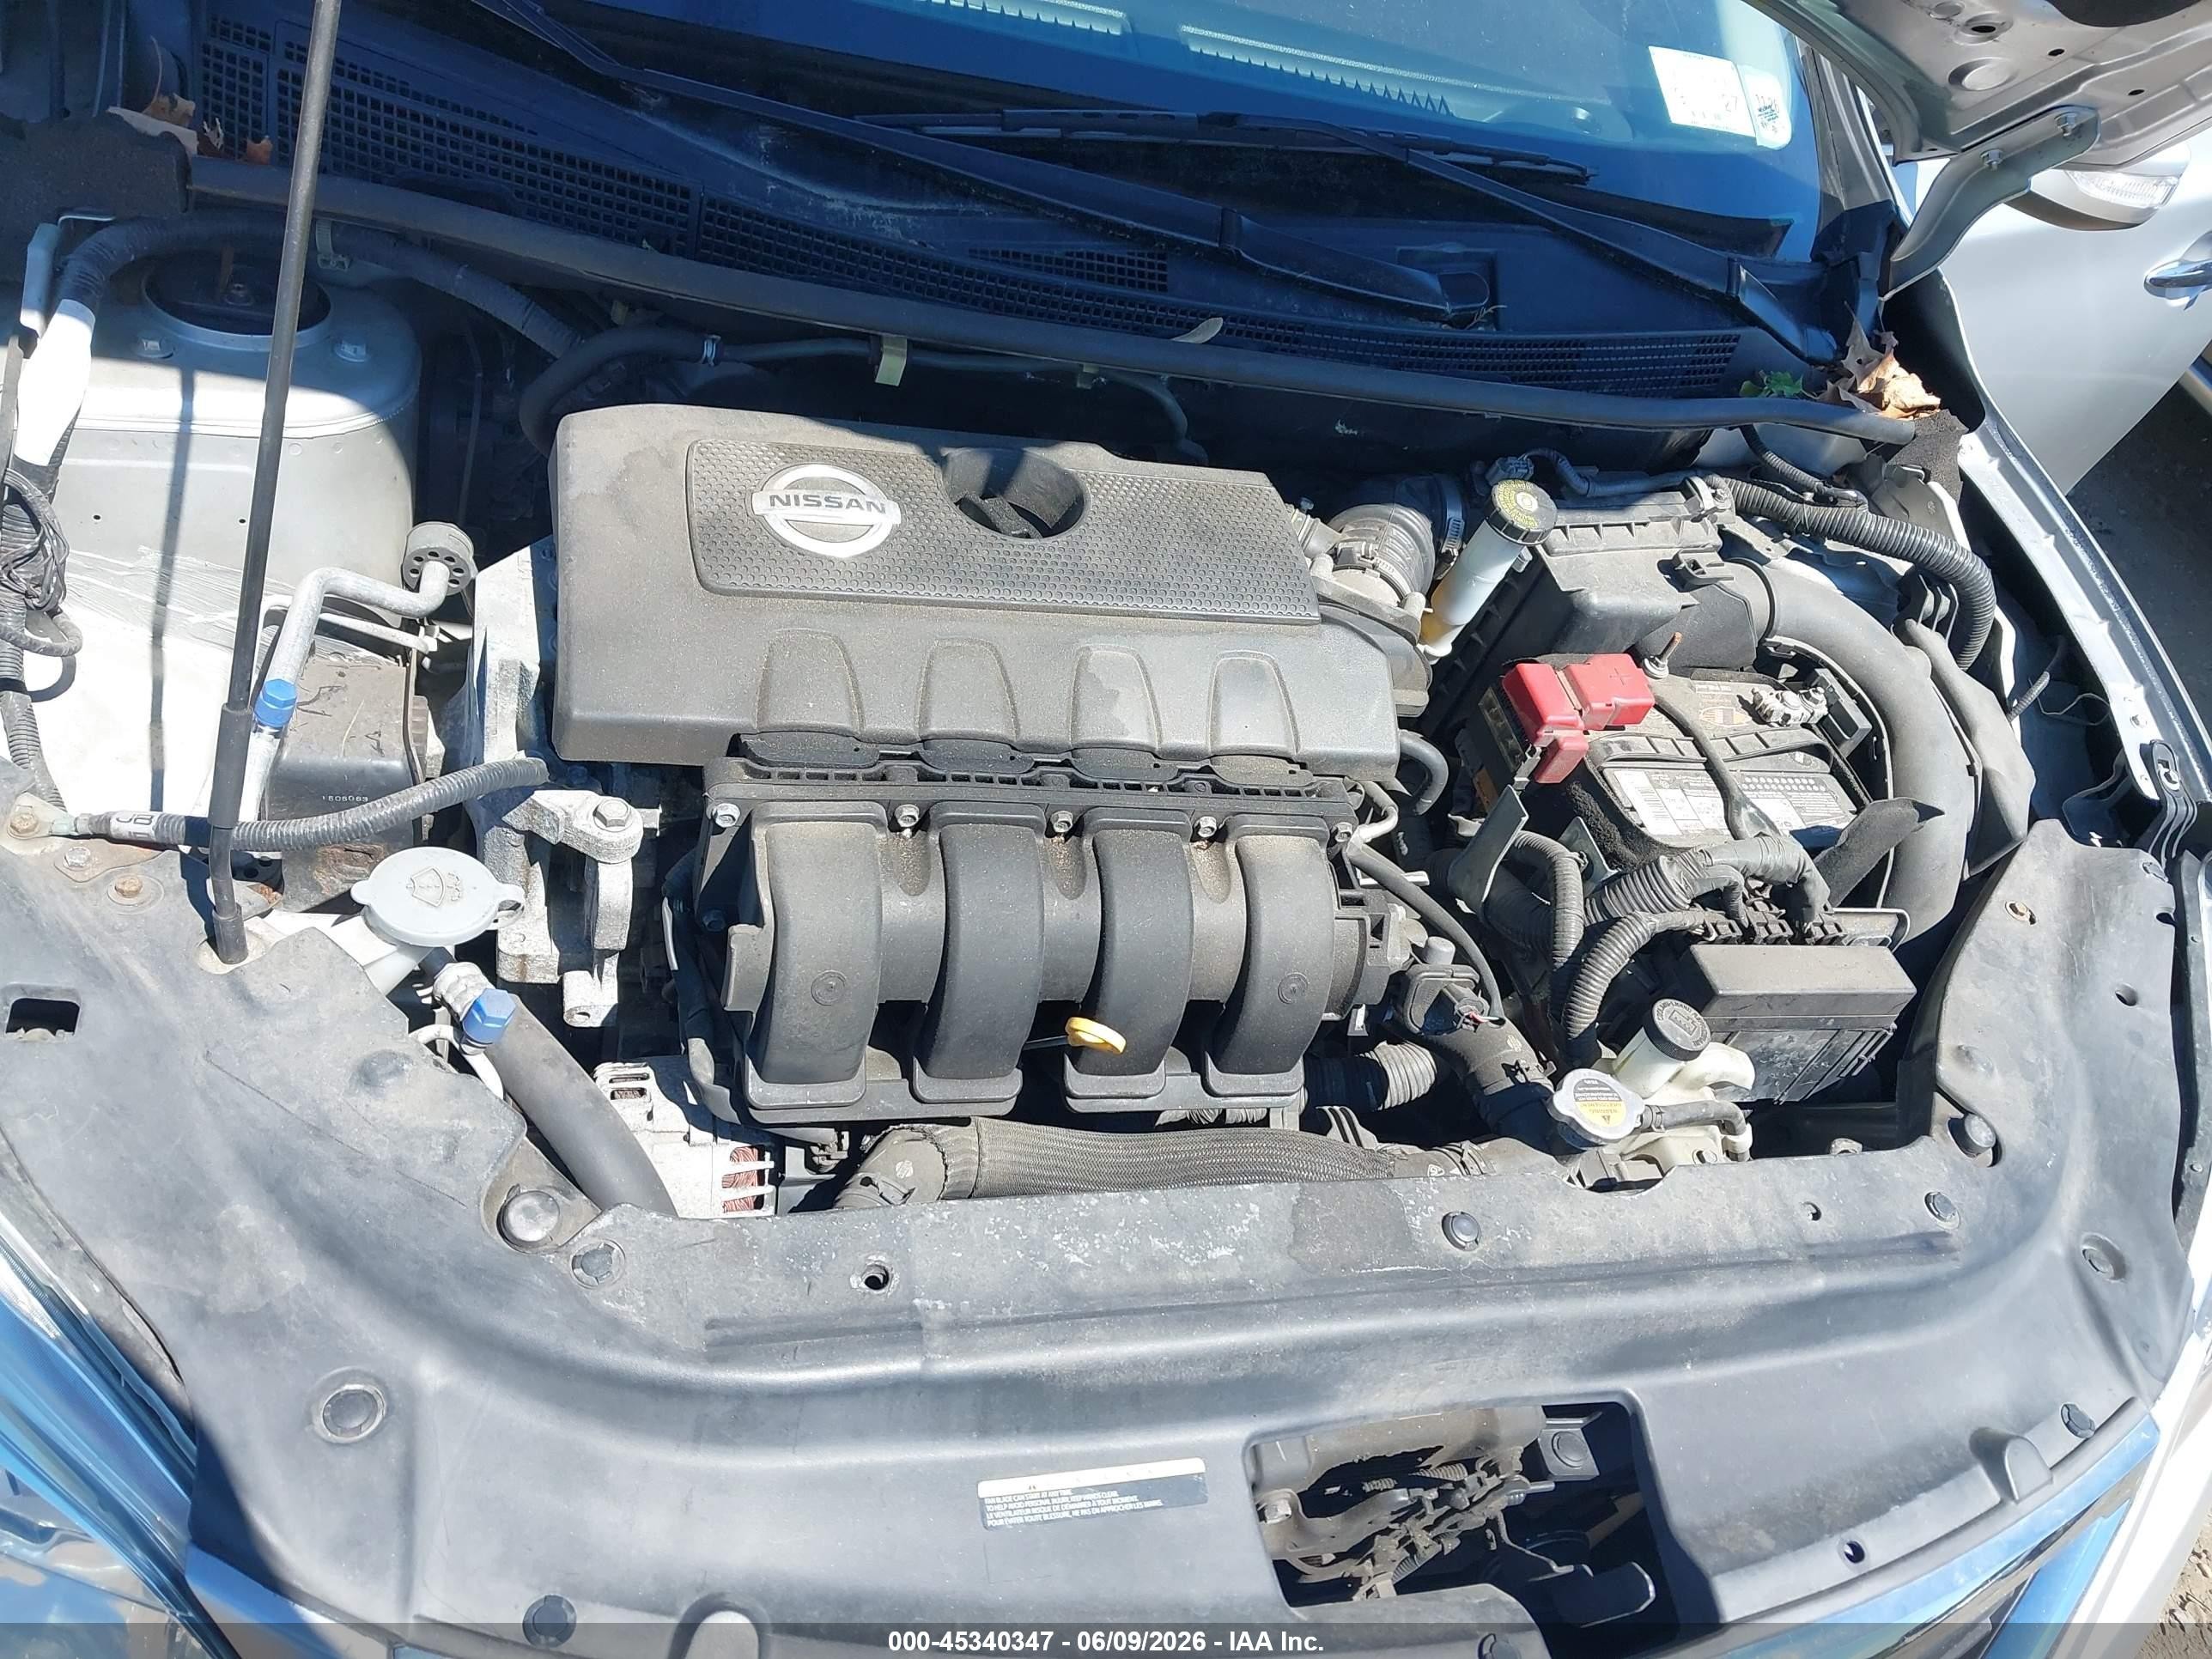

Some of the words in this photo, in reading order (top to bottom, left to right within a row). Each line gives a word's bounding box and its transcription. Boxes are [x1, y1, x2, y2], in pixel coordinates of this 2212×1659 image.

[769, 494, 886, 514] NISSAN
[1013, 1493, 1025, 1502] CAN
[994, 1503, 1008, 1511] HELP
